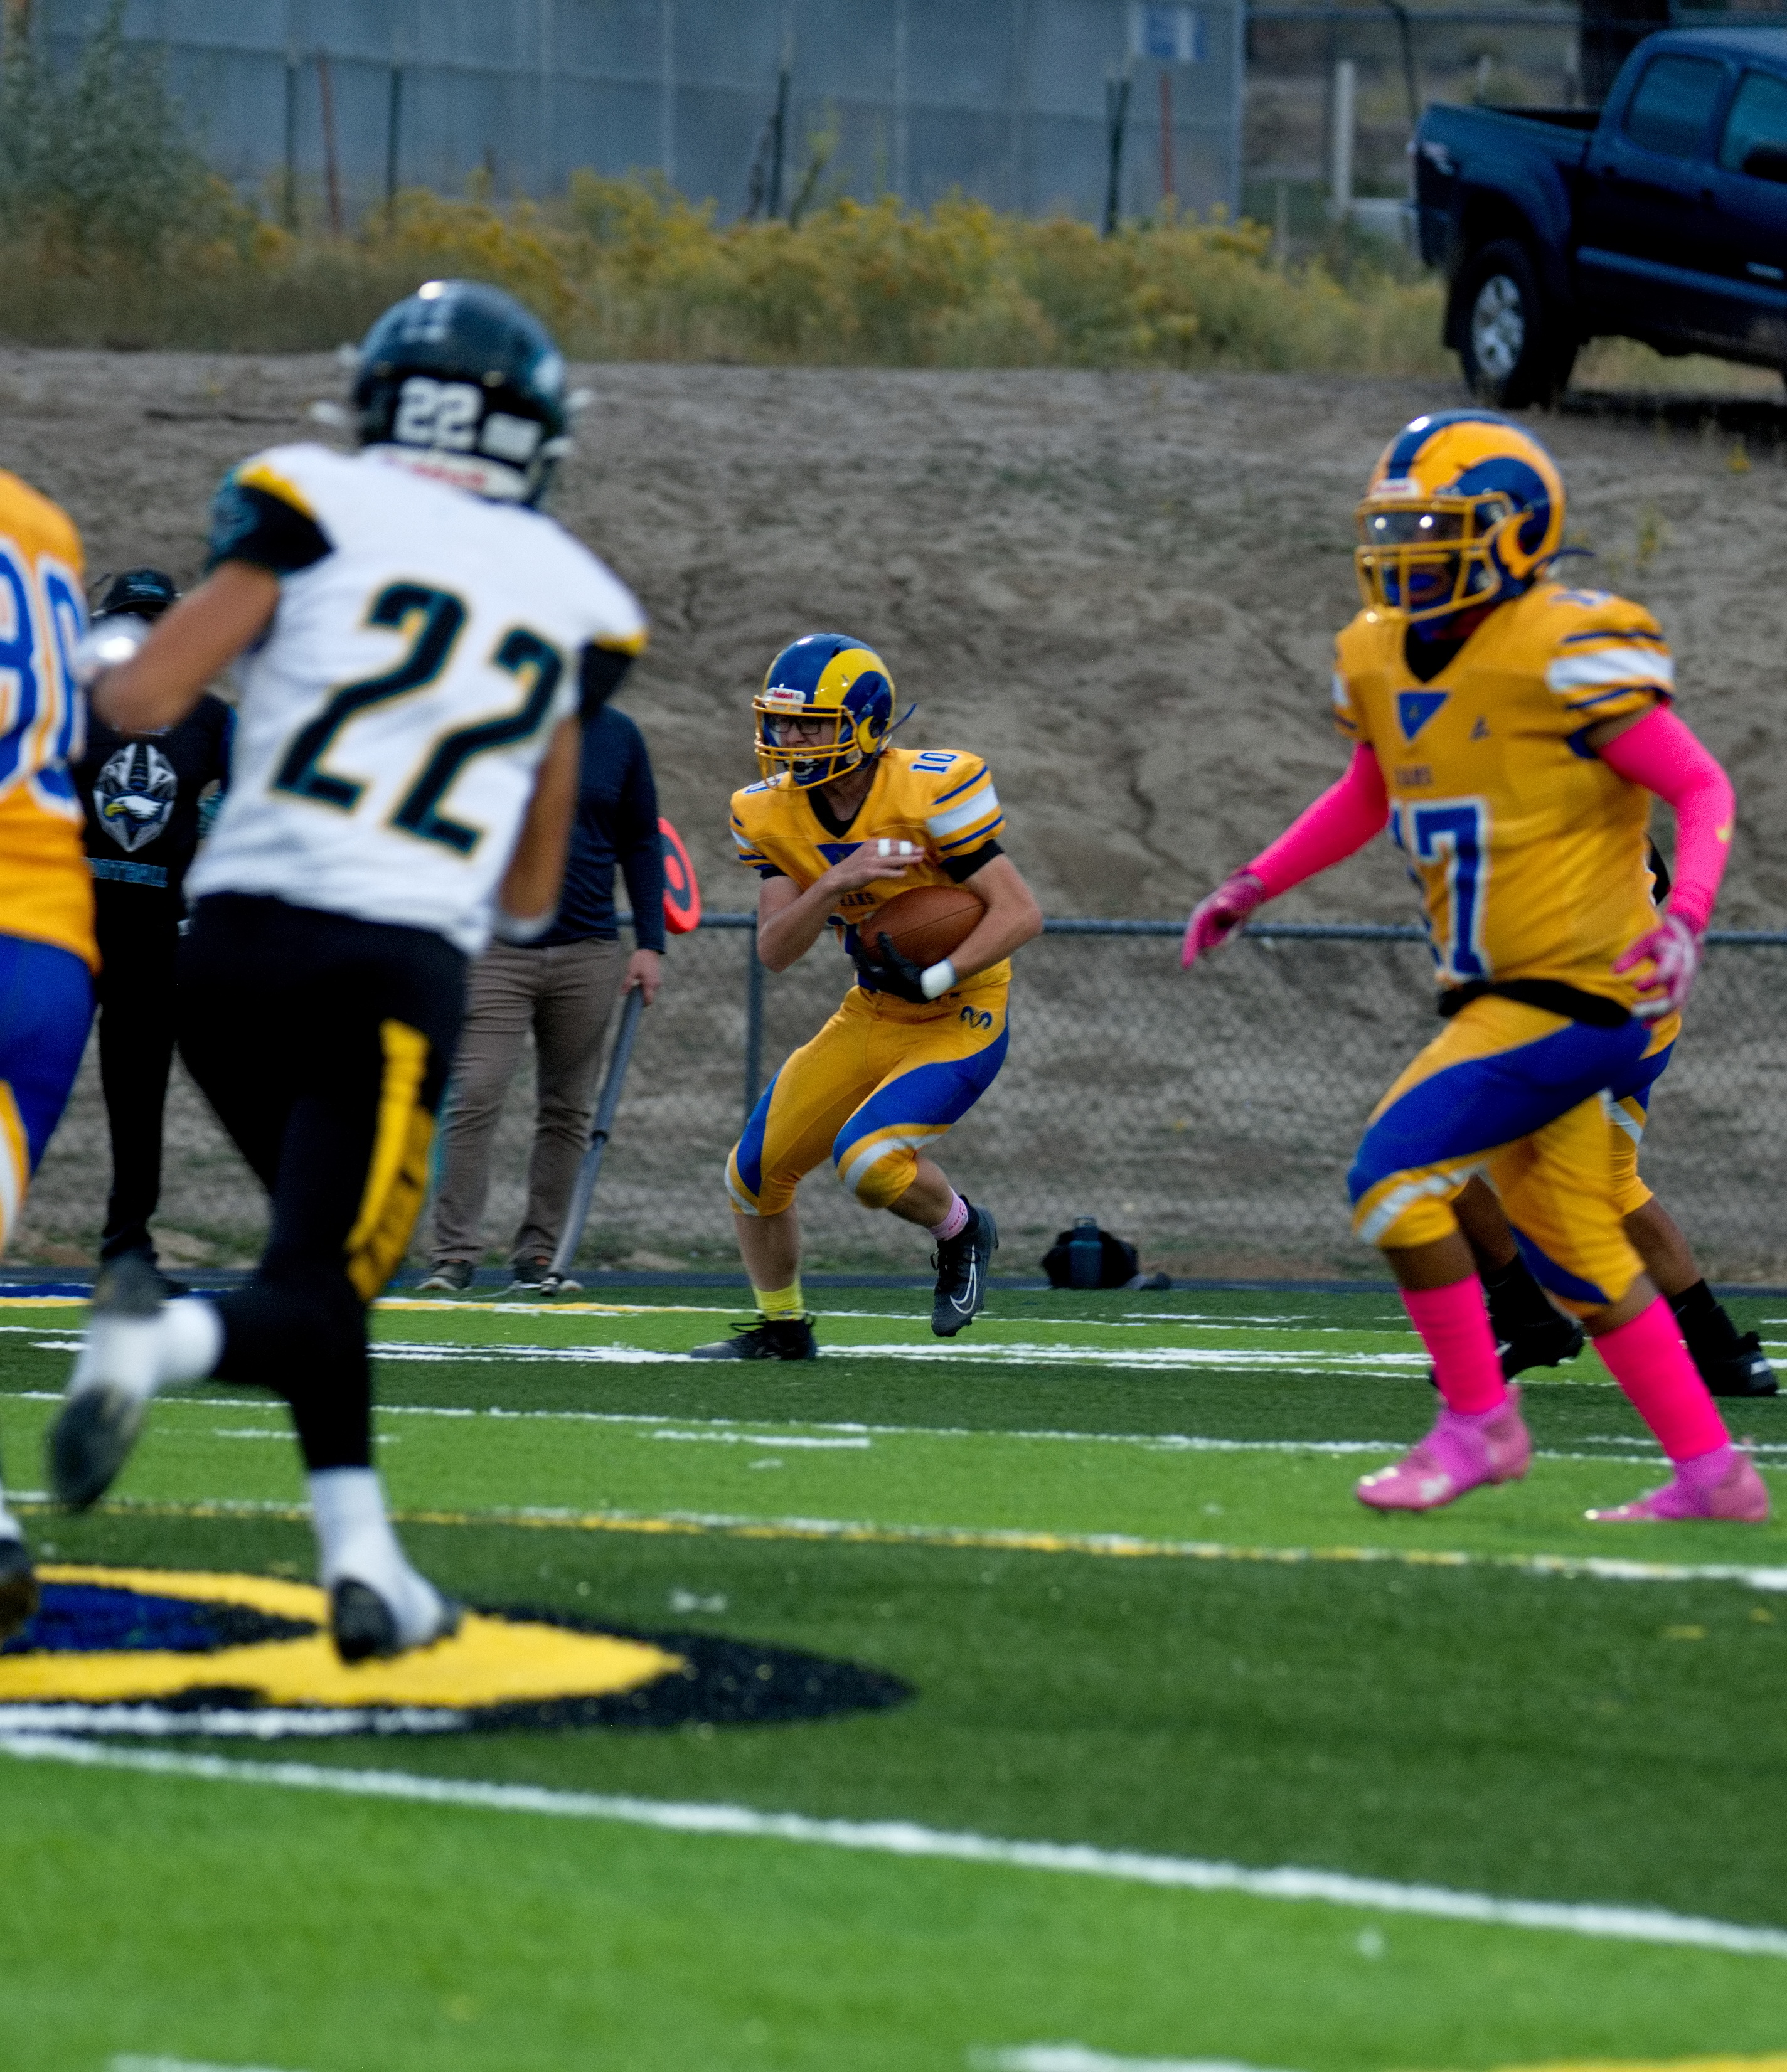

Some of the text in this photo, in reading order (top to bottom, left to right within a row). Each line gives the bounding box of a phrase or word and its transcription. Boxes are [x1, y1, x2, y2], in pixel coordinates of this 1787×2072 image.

[394, 375, 484, 450] 22
[271, 583, 565, 857] 22
[910, 751, 960, 774] 10
[1388, 799, 1490, 981] 7
